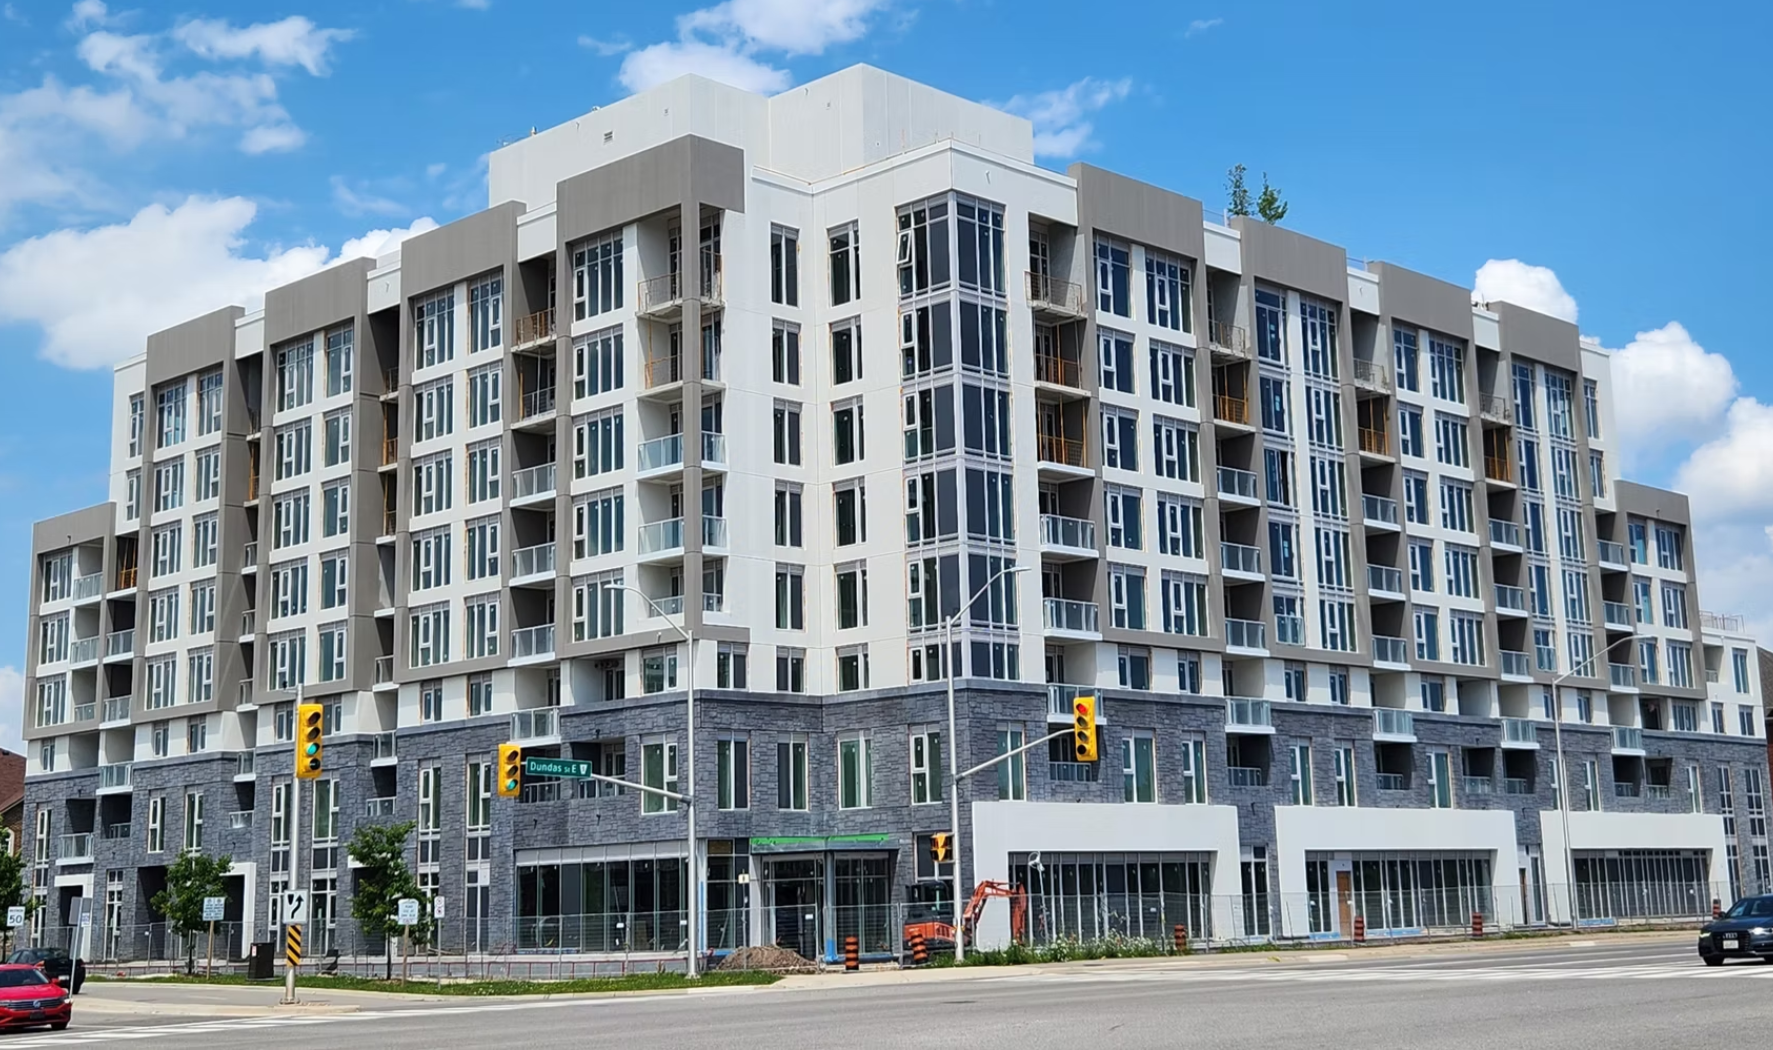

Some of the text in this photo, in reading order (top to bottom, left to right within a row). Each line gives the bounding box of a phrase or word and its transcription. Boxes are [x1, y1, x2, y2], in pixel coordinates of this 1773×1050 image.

[530, 761, 562, 773] Dundas
[572, 764, 577, 773] E
[9, 914, 23, 924] 50
